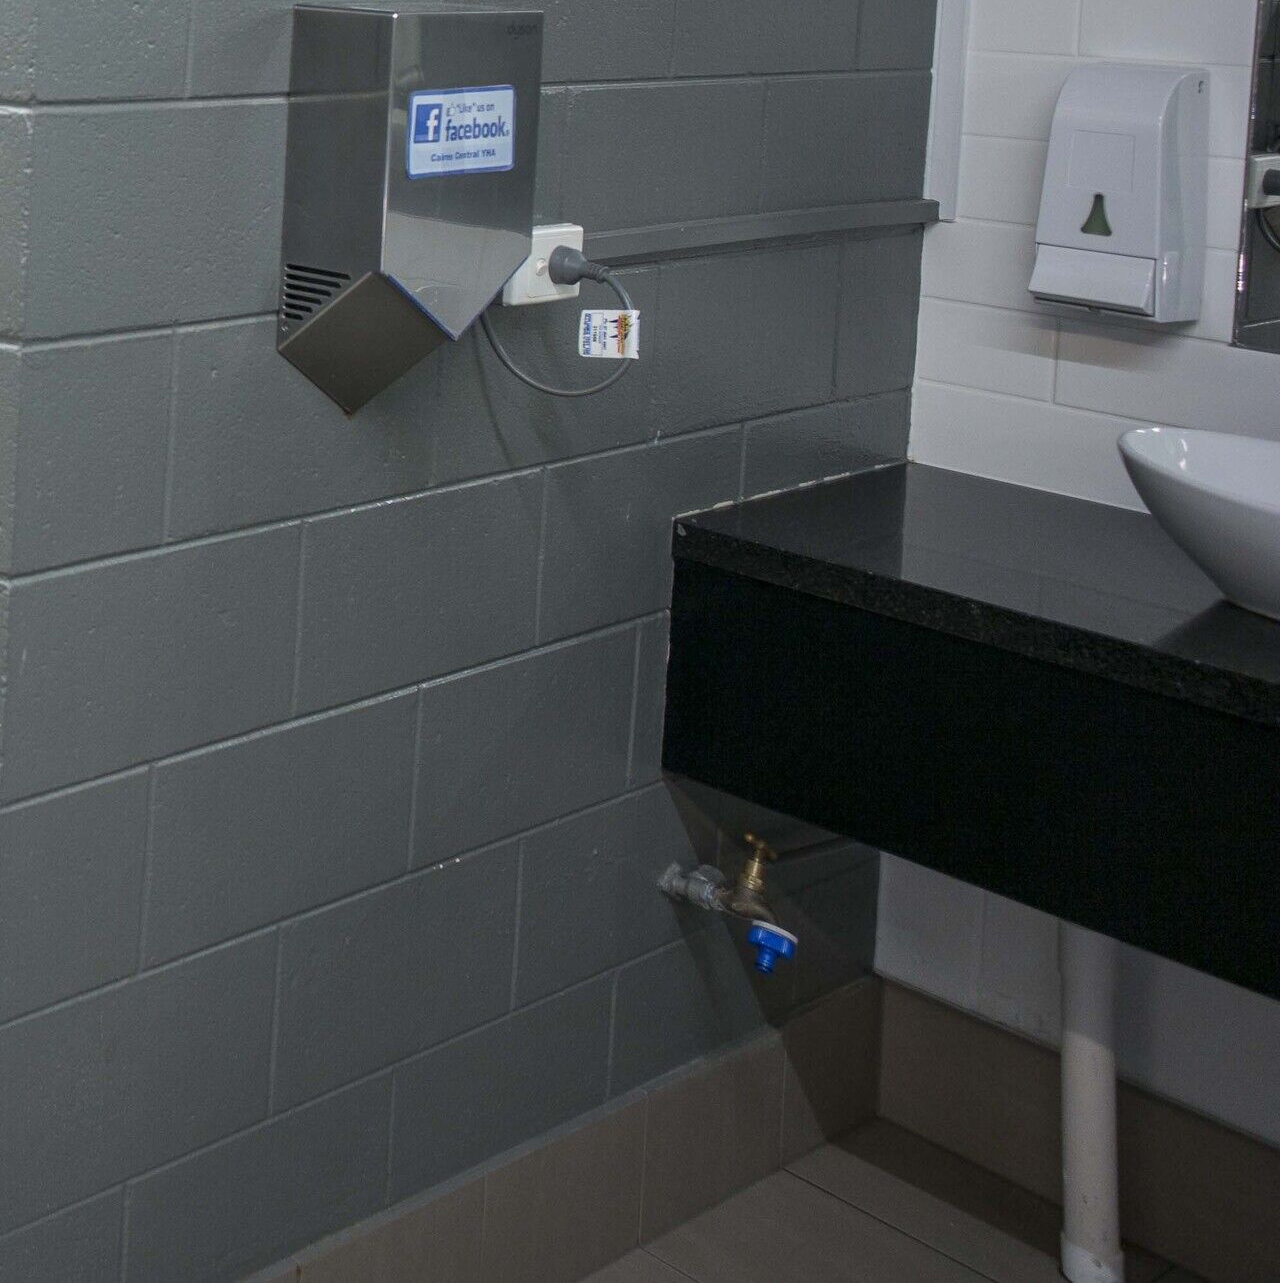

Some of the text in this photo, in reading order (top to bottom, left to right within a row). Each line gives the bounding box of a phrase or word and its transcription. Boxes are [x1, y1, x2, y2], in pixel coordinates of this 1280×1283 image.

[507, 21, 537, 40] dyson
[476, 104, 485, 112] us
[486, 102, 495, 111] on
[455, 151, 480, 159] Central
[481, 149, 496, 157] YHA
